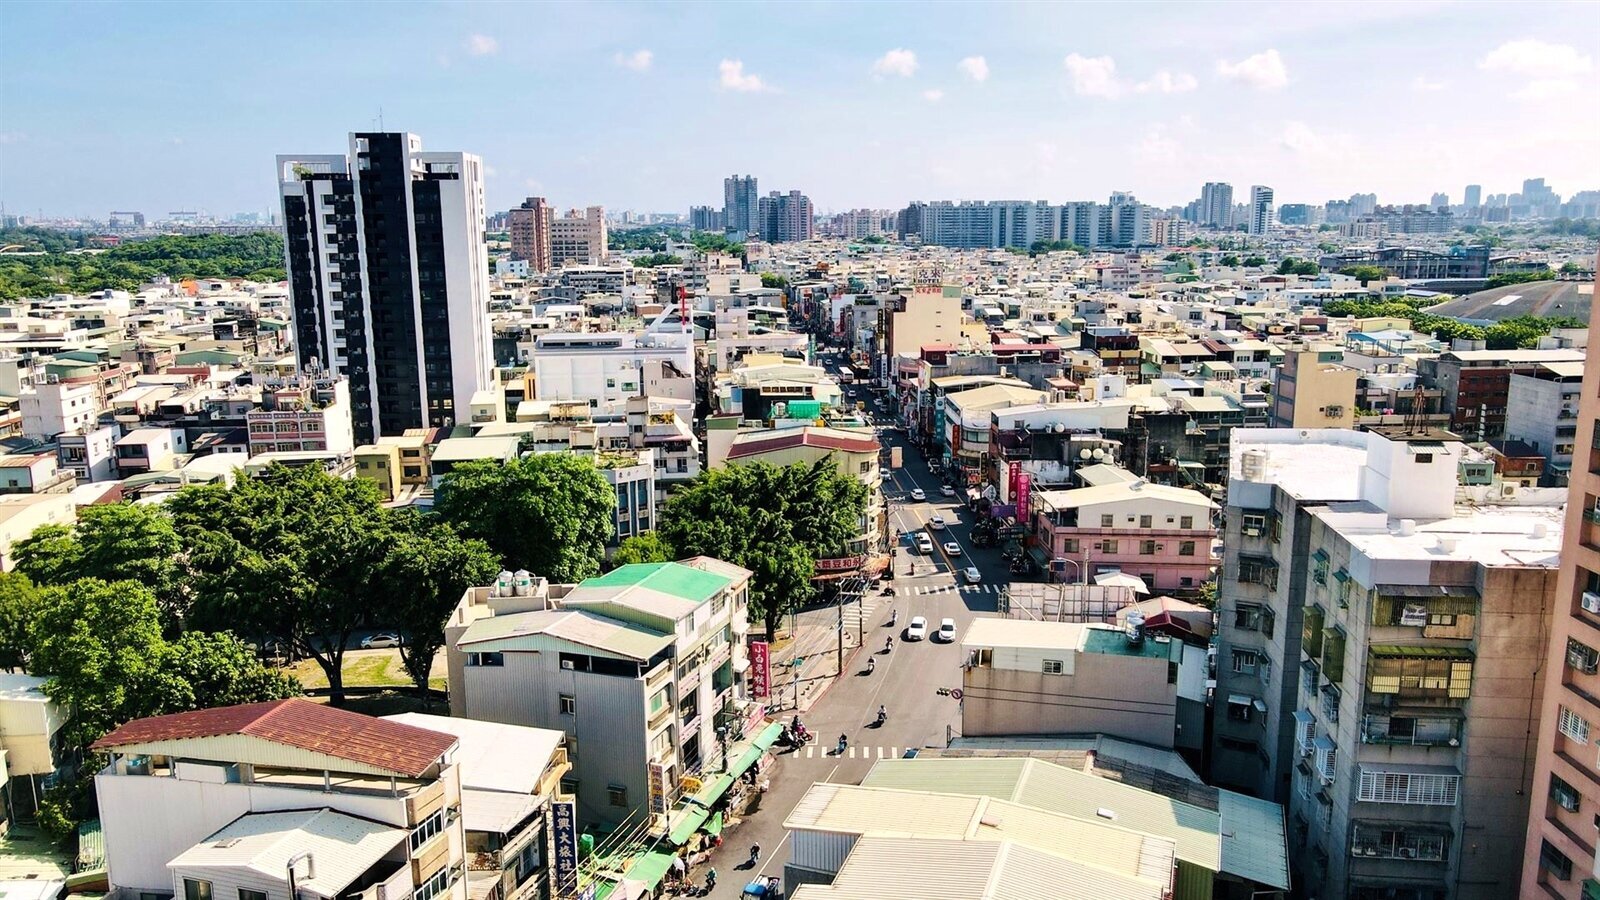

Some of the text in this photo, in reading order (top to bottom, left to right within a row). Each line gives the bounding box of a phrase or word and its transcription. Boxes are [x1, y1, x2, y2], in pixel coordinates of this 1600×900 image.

[556, 804, 574, 872] 高興大旅社
